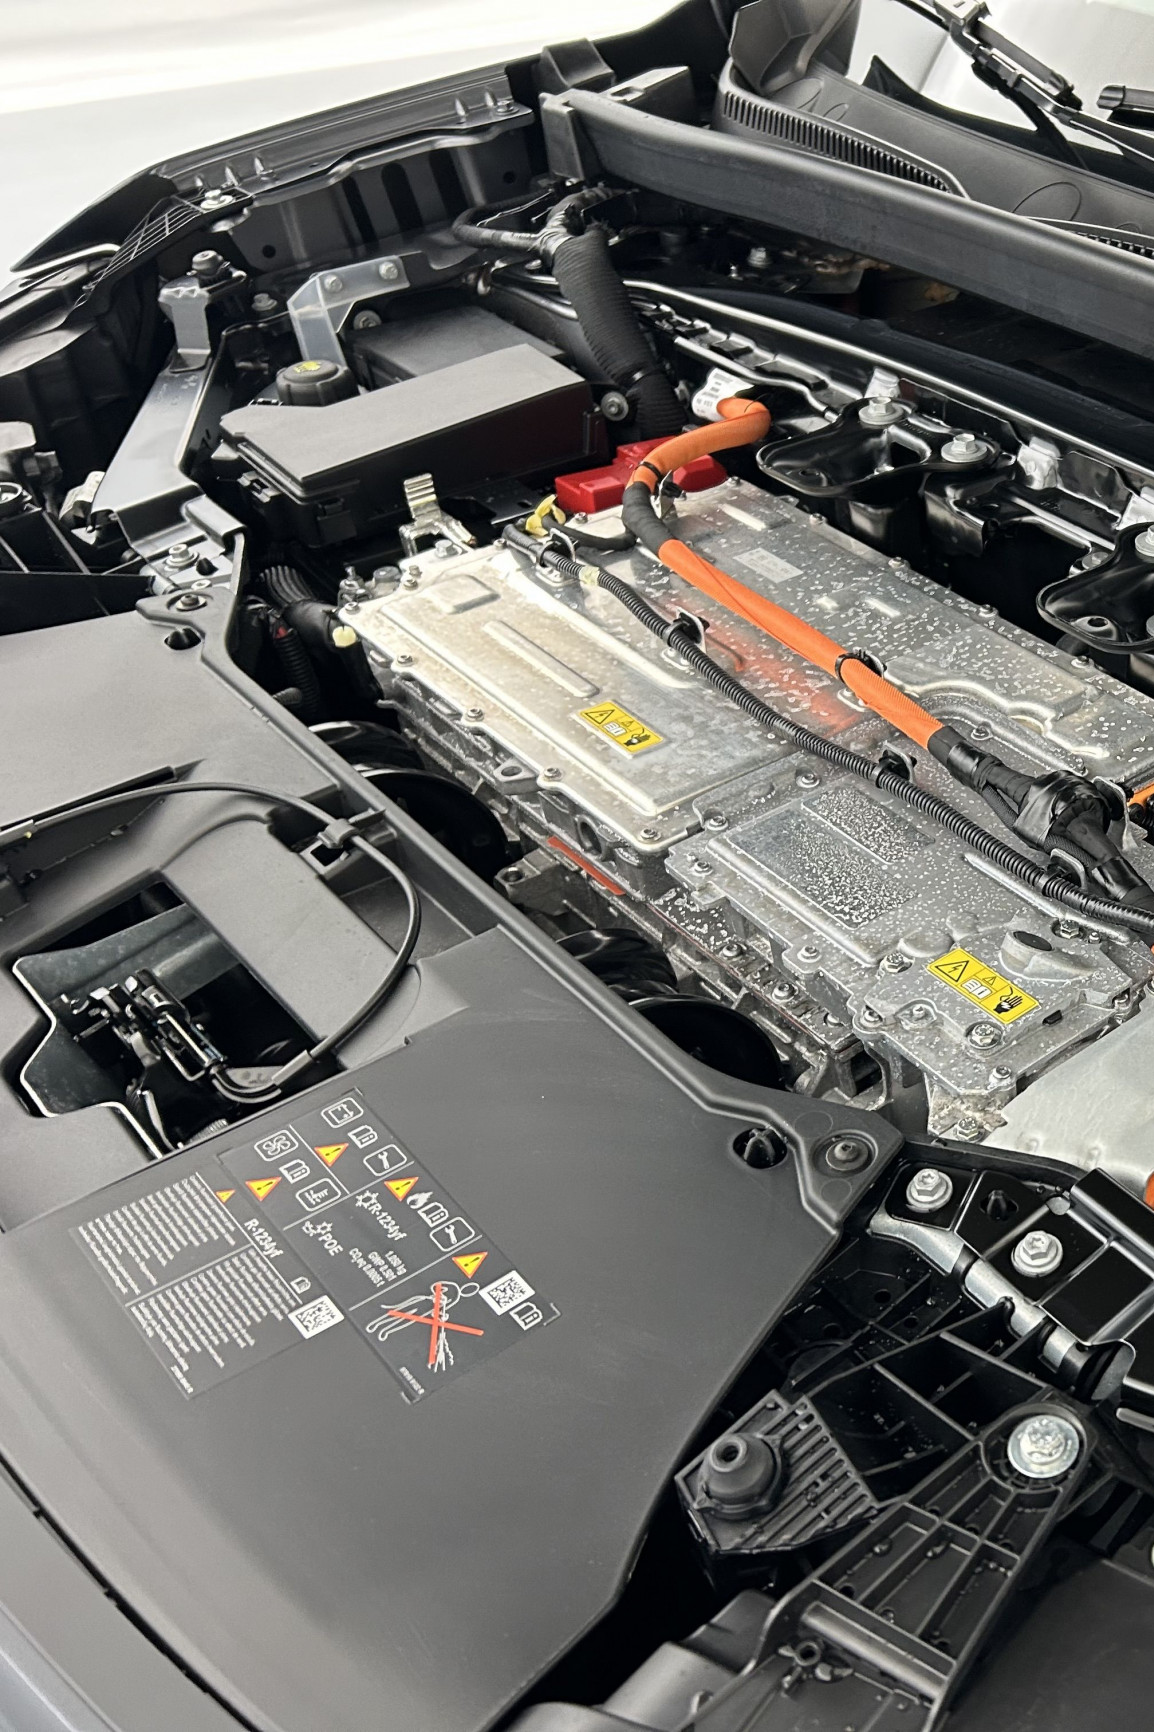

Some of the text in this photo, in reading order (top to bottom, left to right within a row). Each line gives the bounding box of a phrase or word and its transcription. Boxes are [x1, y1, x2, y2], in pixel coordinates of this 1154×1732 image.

[244, 1218, 284, 1259] R-1234yf
[367, 1202, 407, 1241] R-1234yf
[318, 1232, 344, 1257] POE
